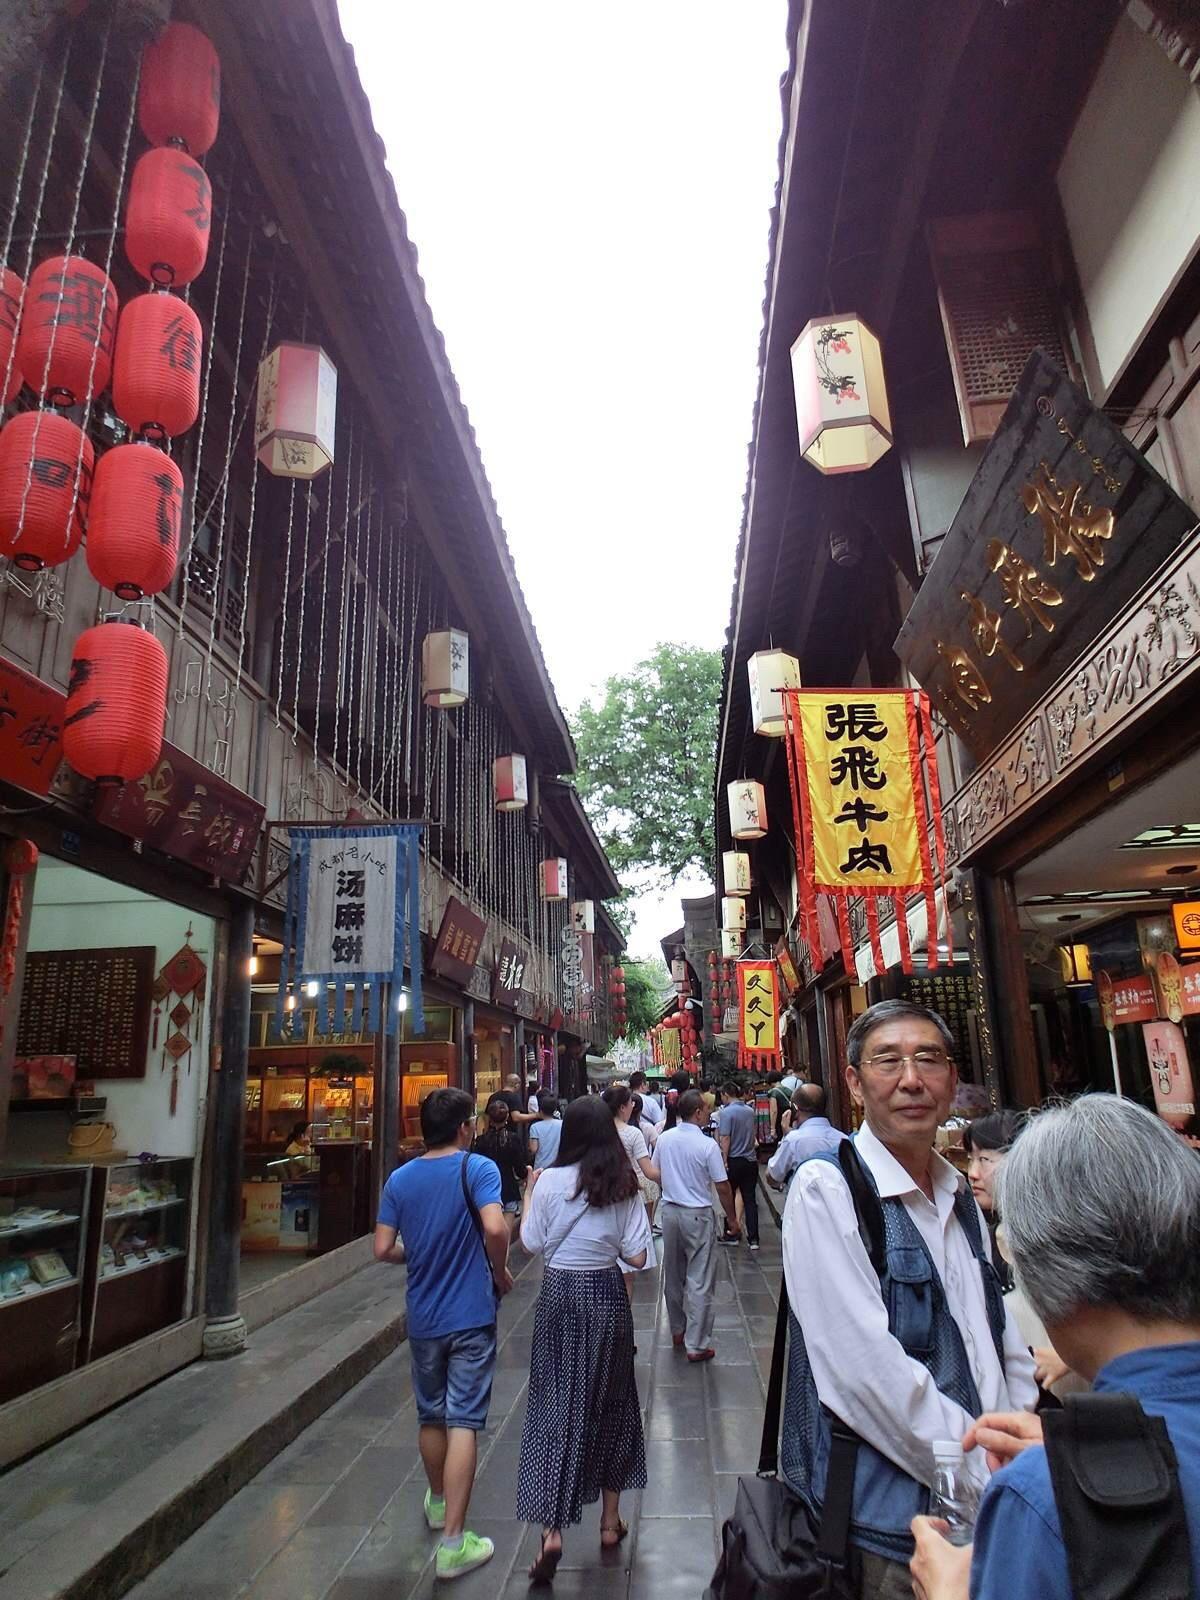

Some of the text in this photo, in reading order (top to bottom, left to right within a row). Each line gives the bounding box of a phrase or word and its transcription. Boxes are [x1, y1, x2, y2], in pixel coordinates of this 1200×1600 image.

[825, 703, 894, 875] 張飛牛肉
[318, 846, 389, 876] 成都名小吃
[331, 869, 366, 964] 汤麻饼
[746, 974, 773, 1046] 久久丫
